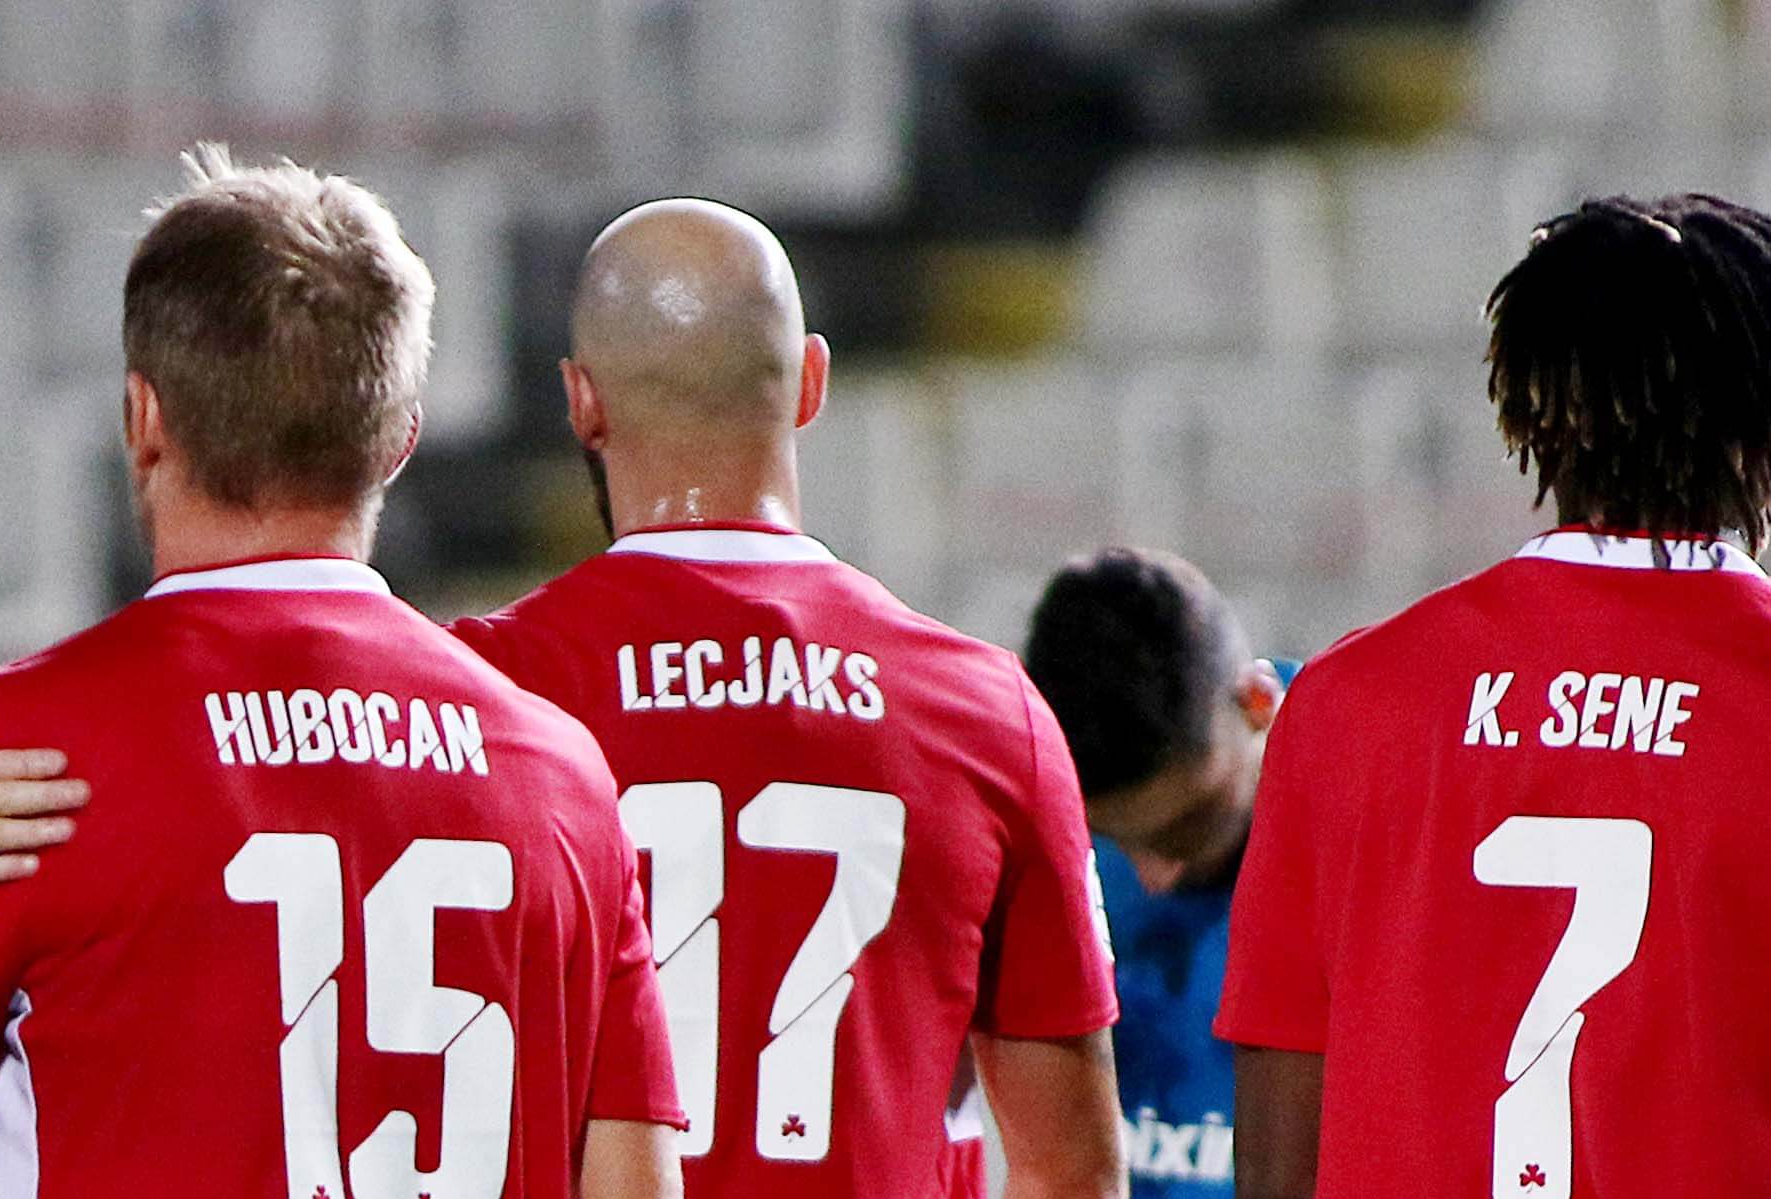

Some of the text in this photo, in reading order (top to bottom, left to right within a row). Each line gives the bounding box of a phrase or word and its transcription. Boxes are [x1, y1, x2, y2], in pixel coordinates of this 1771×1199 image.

[617, 635, 886, 721] LECJAKS
[1462, 670, 1701, 757] K. SENE
[203, 687, 490, 777] HUBOCAN
[617, 780, 907, 1164] 17
